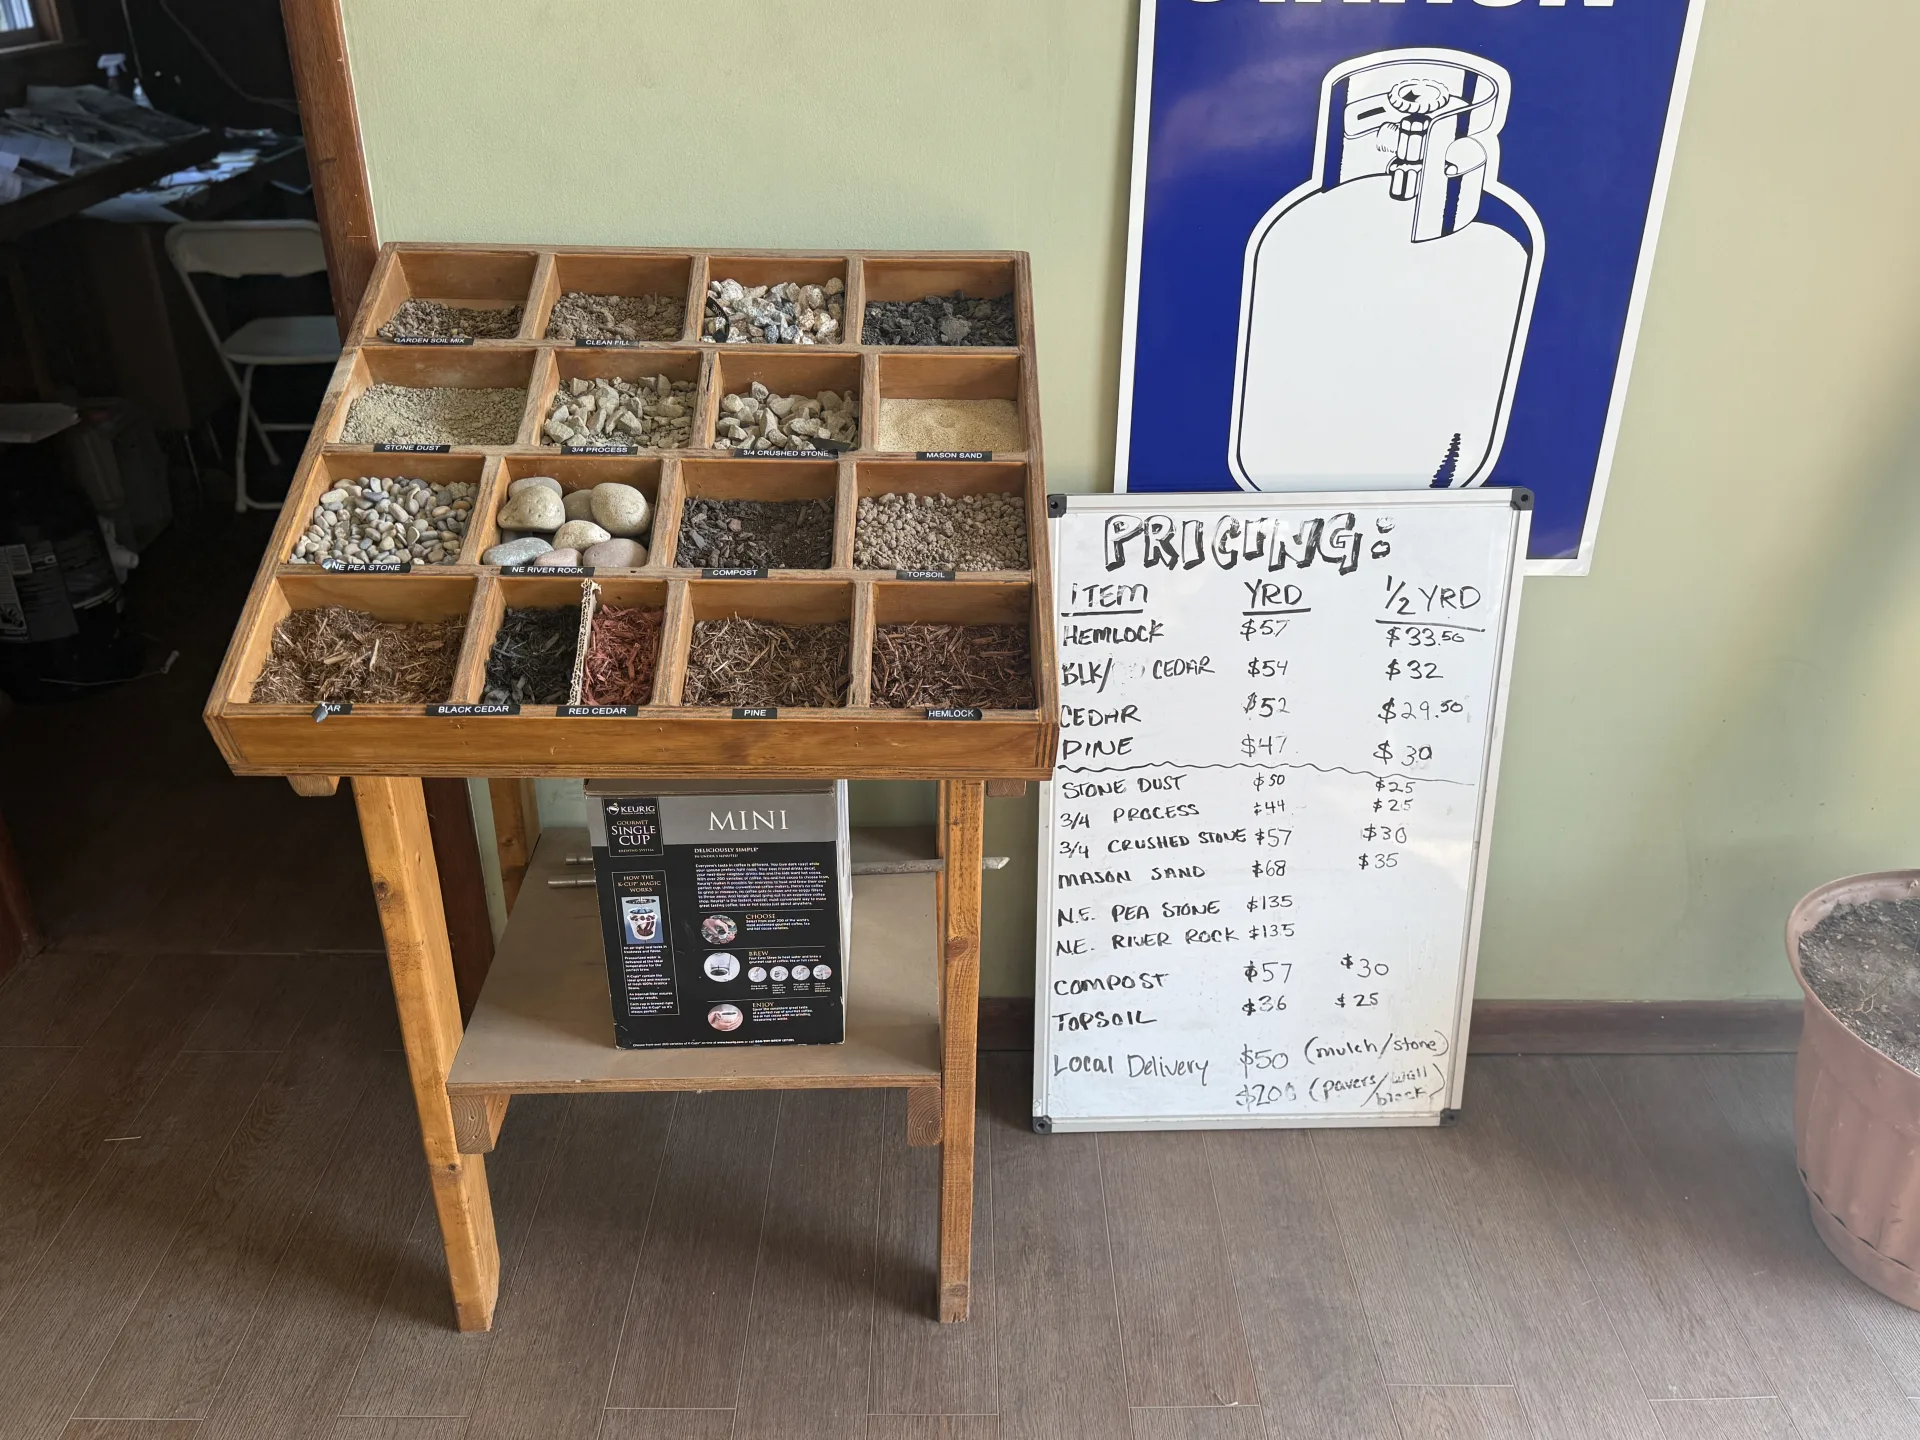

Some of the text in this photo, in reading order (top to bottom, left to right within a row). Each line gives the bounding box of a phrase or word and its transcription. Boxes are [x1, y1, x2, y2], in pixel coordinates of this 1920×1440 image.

[1103, 512, 1395, 575] PRICING:
[331, 561, 346, 571] NE
[527, 566, 555, 574] RIVER
[1071, 575, 1481, 615] ITEM YRD 1/2 YRD
[1063, 619, 1164, 646] HEMLOCK
[1240, 618, 1290, 641] $57
[1061, 655, 1444, 694] BLK/ CEDAR $54 $32
[438, 705, 509, 714] BLACK CEDAR
[568, 707, 627, 715] RED CEDAR
[743, 709, 767, 717] PINE
[928, 709, 974, 718] HEMLOCK
[1060, 692, 1463, 728] CEDAR $52 $29.50
[1062, 736, 1134, 760] PINE
[1241, 734, 1288, 758] $47
[1062, 772, 1416, 799] STONE DUST $50 $25
[709, 810, 788, 831] MINI
[1060, 798, 1413, 830] 3/4 PROCESS $44 $25
[612, 826, 656, 835] SINGLE
[619, 835, 650, 846] CUP
[1059, 823, 1407, 858] 3/4 CRUSHED STONE $57 $30
[1058, 852, 1399, 889] MASON SAND $68 $35
[1057, 895, 1293, 927] N.E. PEA STONE $135
[1111, 932, 1172, 950] RIVER
[1185, 927, 1240, 945] ROCK
[1249, 923, 1295, 940] $135
[1054, 954, 1389, 996] COMPOST $57 $30
[1052, 992, 1379, 1032] TOPSOIL $36 $25
[1128, 1053, 1208, 1086] Delivery
[1240, 1044, 1289, 1079] $50
